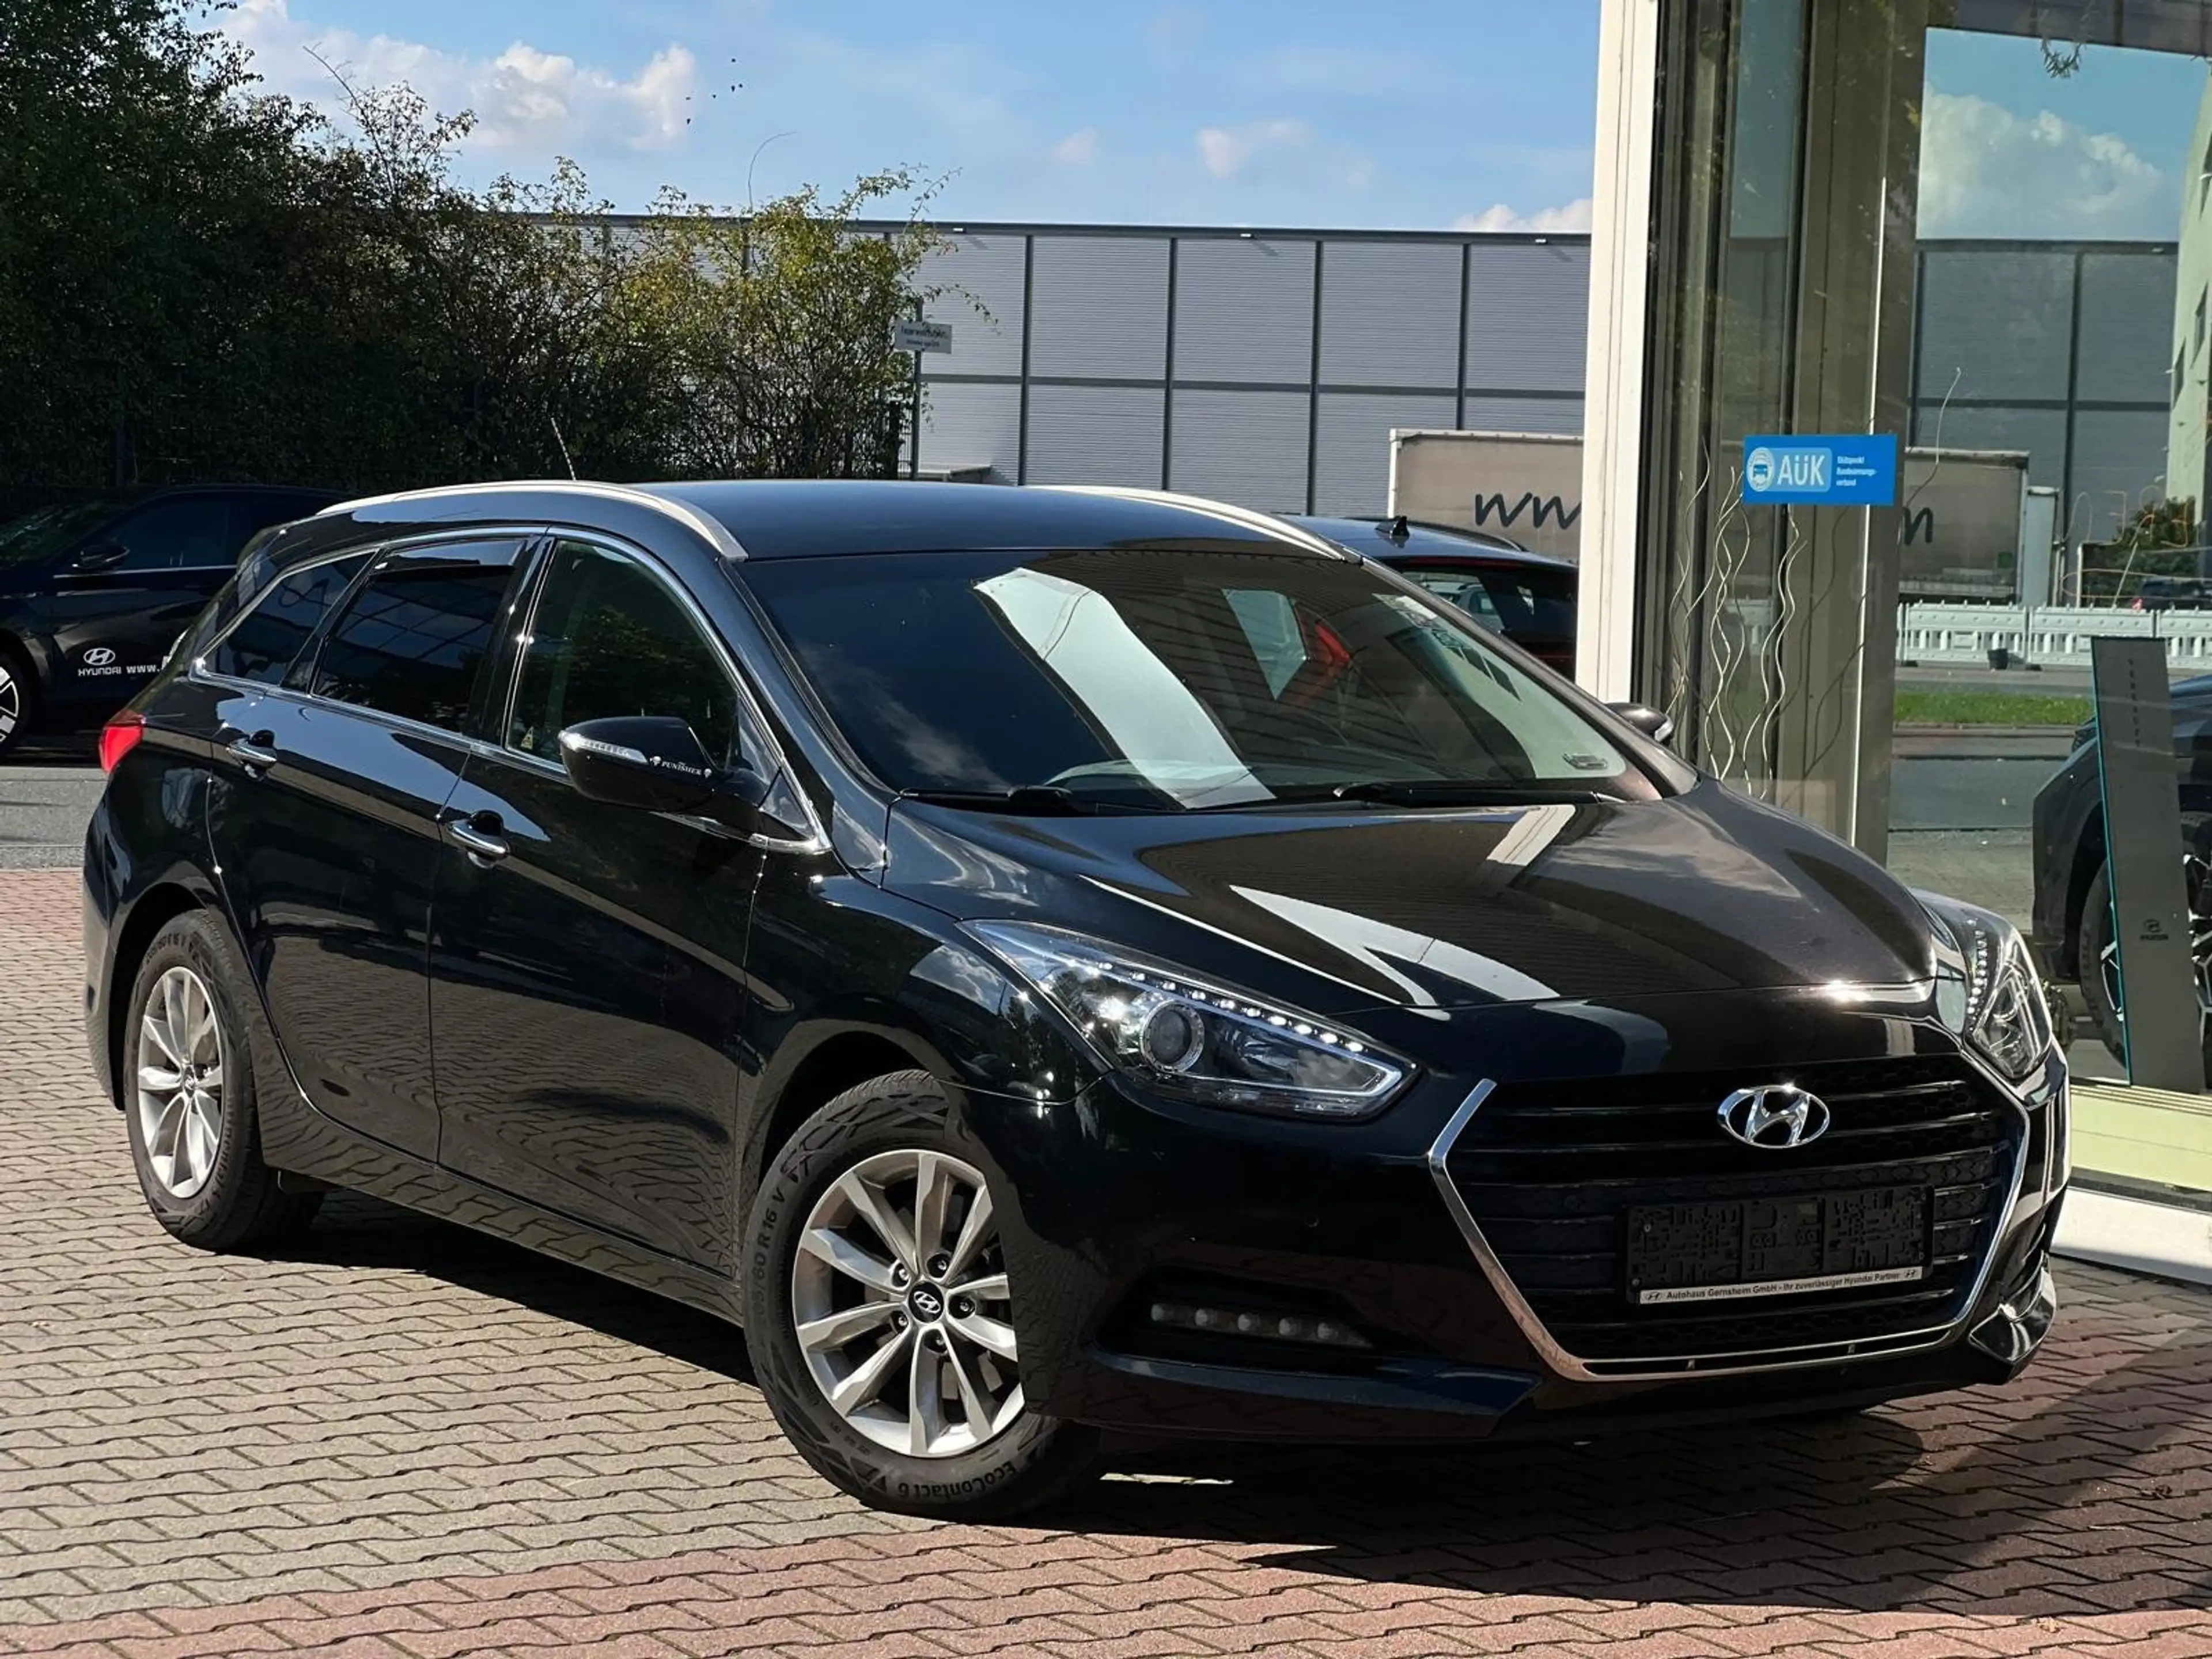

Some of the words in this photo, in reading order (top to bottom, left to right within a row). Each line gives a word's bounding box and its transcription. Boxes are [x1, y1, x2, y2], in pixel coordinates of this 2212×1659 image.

[1777, 454, 1825, 486] AÜK
[77, 666, 122, 677] HYUNDAI
[1666, 1290, 1706, 1300] Autohaus
[1752, 1284, 1777, 1294] GmbH
[1783, 1282, 1793, 1290] Ihr
[1795, 1279, 1843, 1290] zuverlässiger
[1844, 1275, 1873, 1285] Hyundai
[1874, 1272, 1899, 1281] Partner
[897, 1482, 909, 1498] 6
[914, 1461, 1017, 1501] EcoContact
